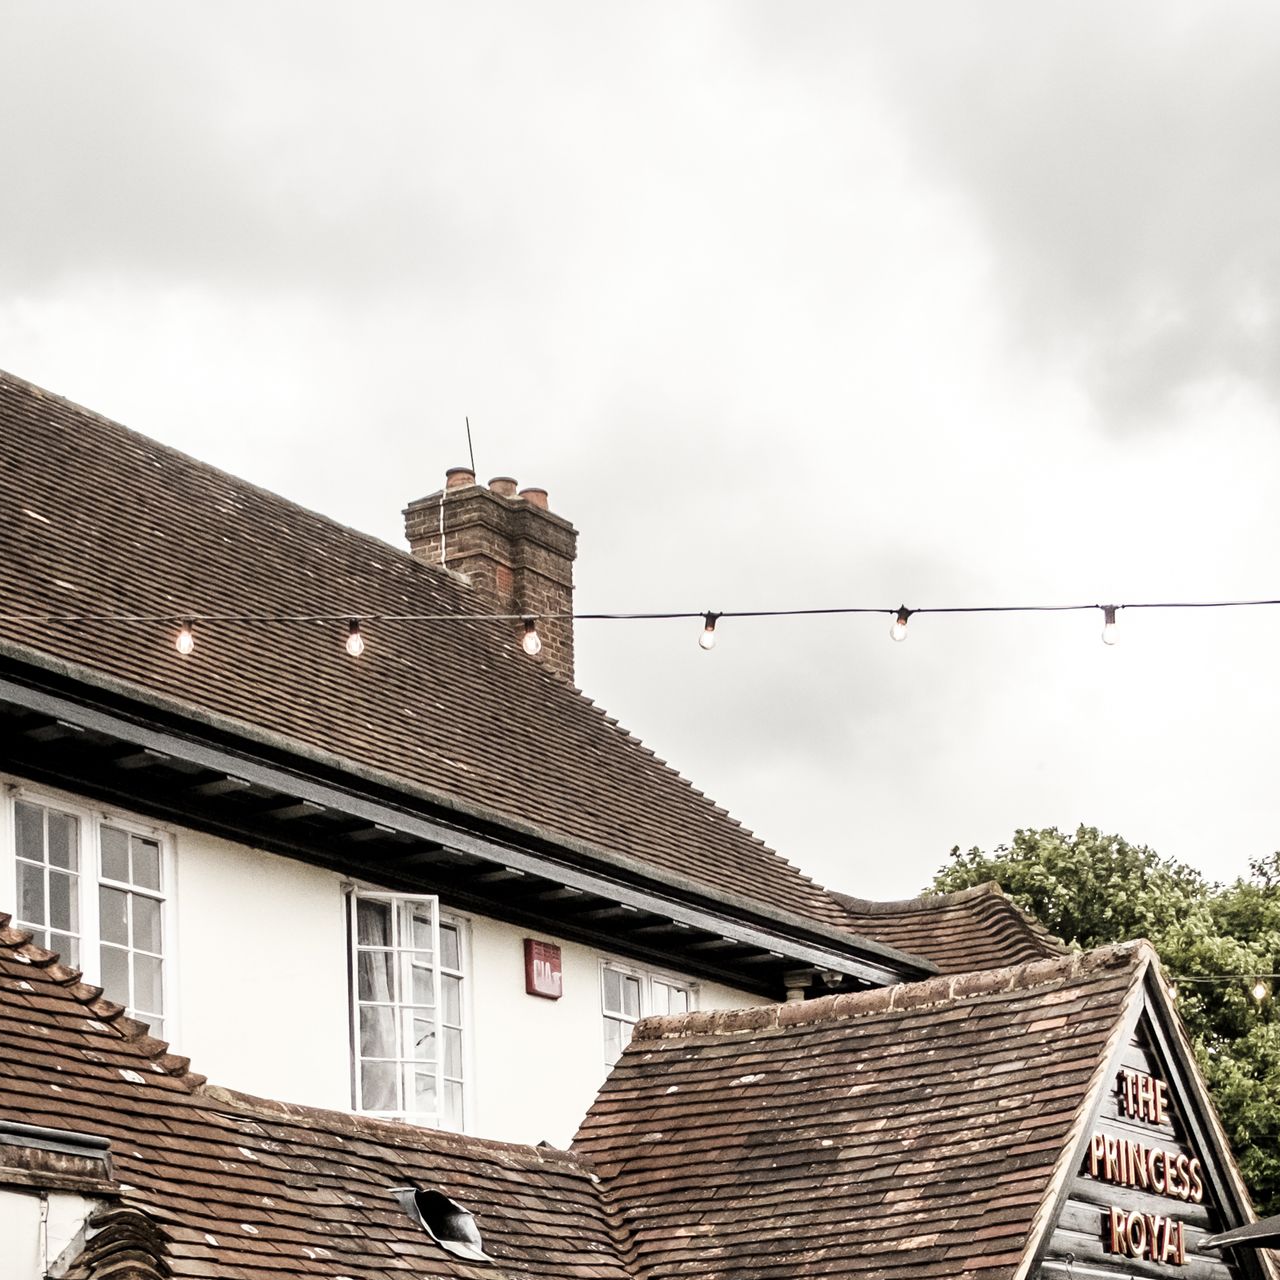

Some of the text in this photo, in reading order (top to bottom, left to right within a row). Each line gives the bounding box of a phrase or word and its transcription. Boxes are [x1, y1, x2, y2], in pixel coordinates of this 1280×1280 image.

[1121, 1071, 1169, 1124] THE
[1091, 1133, 1204, 1204] PRINCESS
[1109, 1205, 1191, 1265] ROYAL
